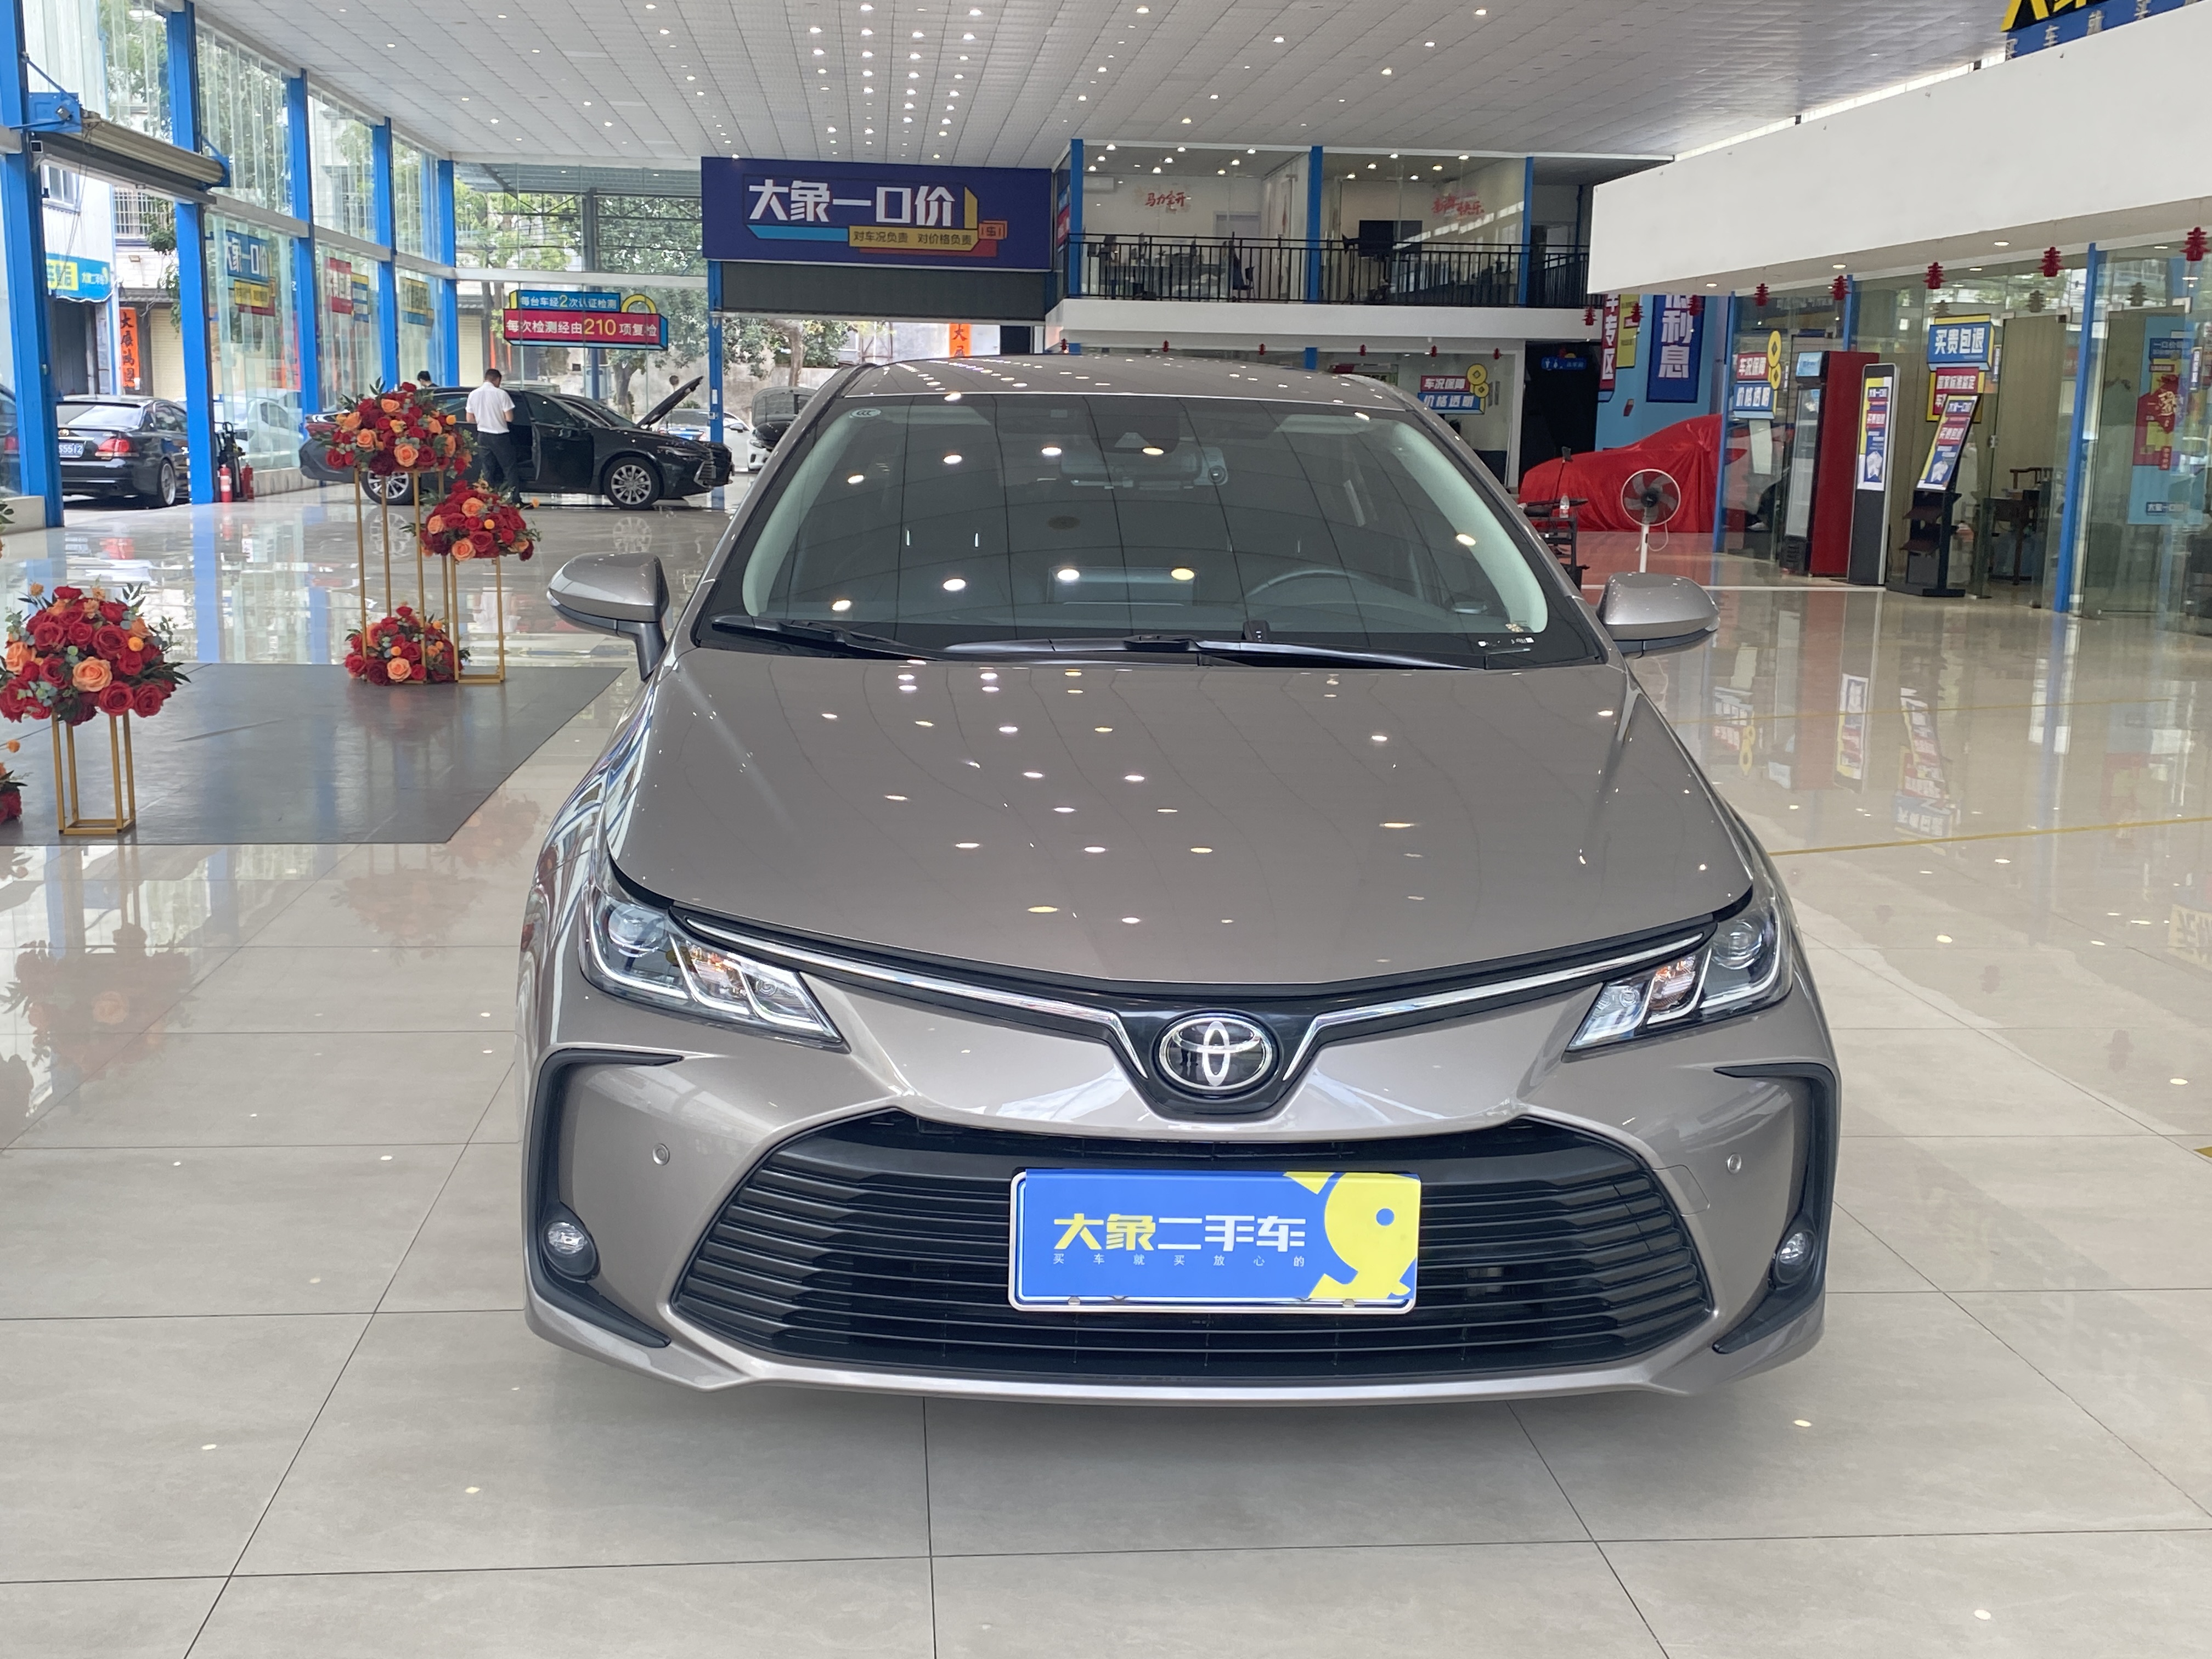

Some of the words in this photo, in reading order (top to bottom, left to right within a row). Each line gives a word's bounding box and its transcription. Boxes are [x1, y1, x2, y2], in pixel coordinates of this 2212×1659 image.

[749, 179, 955, 227] 大象一口价
[854, 230, 908, 244] 对车况负责
[918, 233, 972, 246] 对价格负责
[521, 295, 617, 309] 每台车经2次认证检测
[1934, 328, 1985, 354] 买贵包退
[1424, 379, 1465, 392] 车况保障
[1424, 395, 1474, 408] 价格透明
[1054, 1213, 1306, 1252] 大象二手车
[1053, 1253, 1305, 1267] 买车就买放心的
